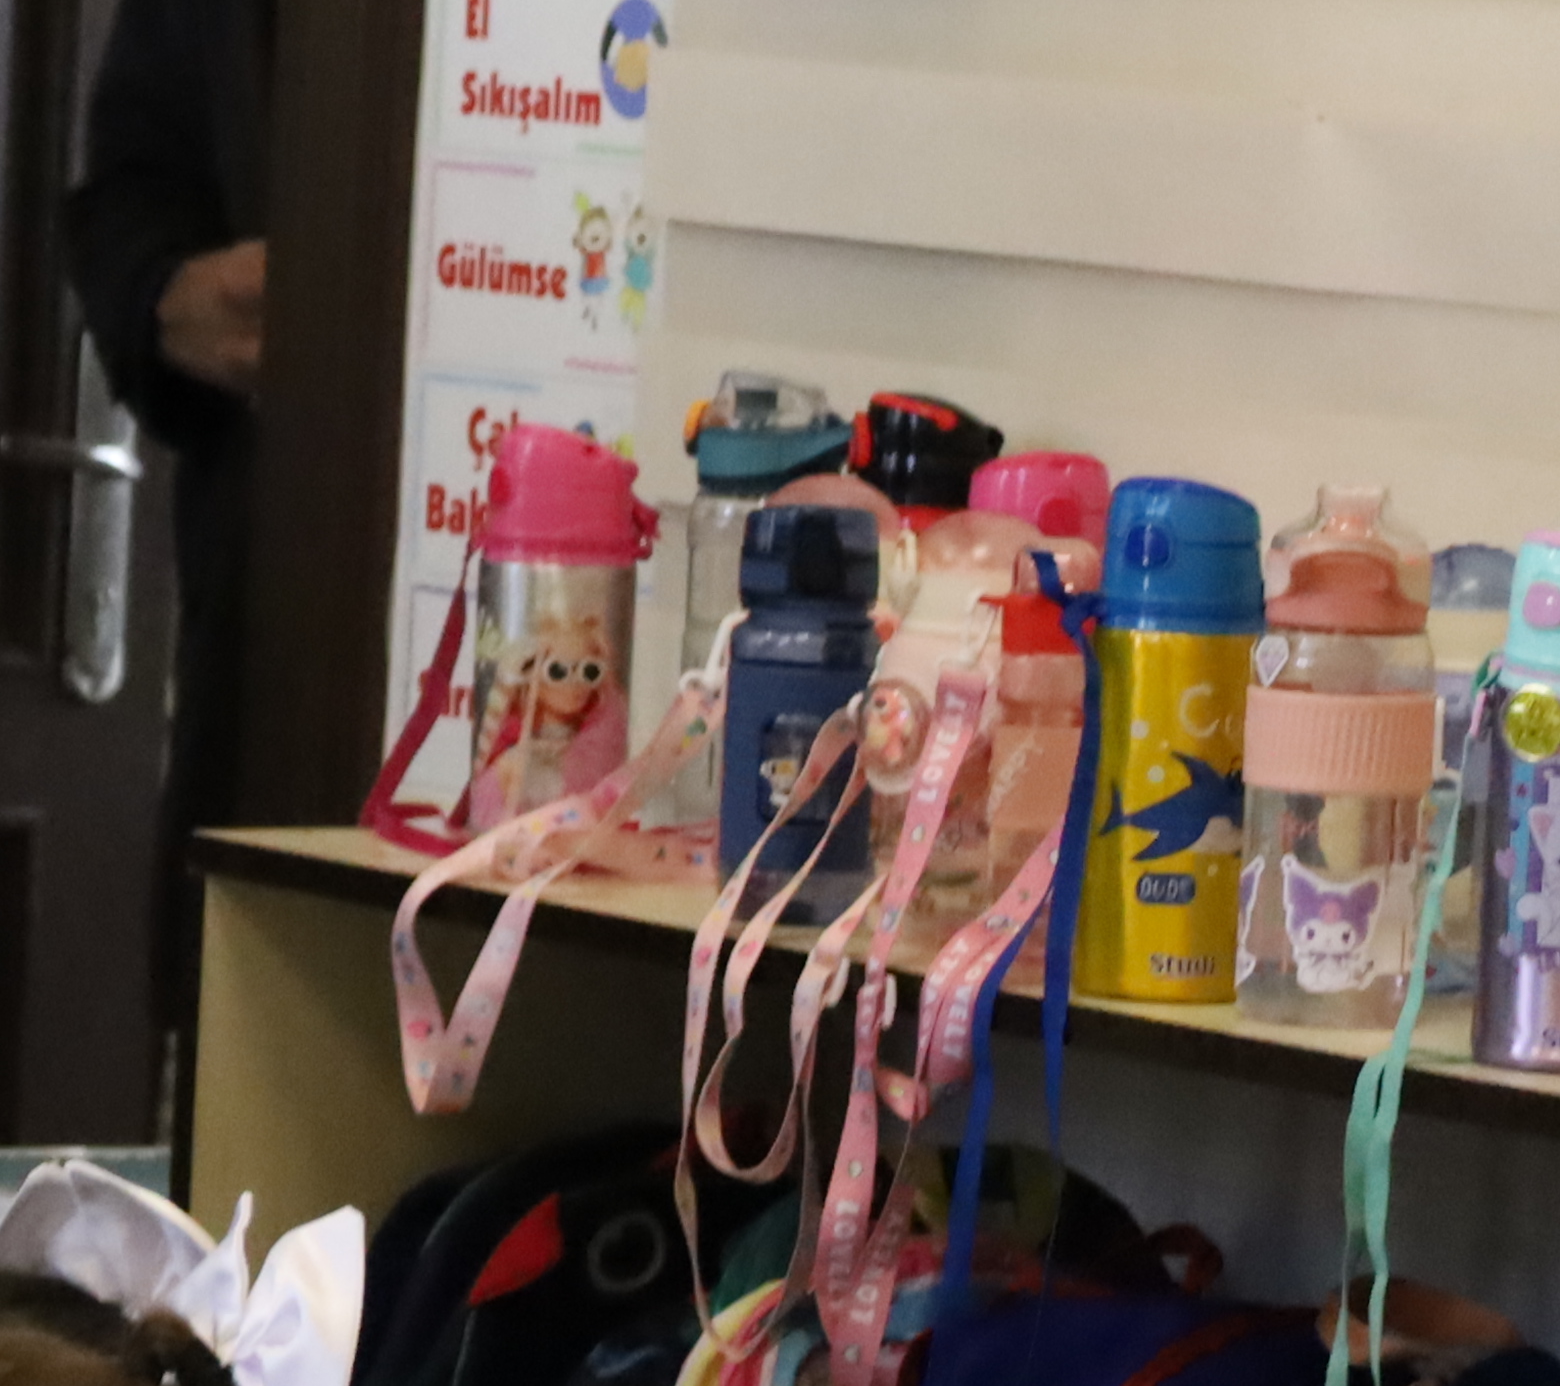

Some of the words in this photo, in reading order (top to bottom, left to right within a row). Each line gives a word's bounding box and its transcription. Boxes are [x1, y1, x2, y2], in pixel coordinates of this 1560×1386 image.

[461, 70, 602, 135] Sıkışalım
[437, 241, 568, 301] Gülümse
[917, 690, 968, 804] LOVELY
